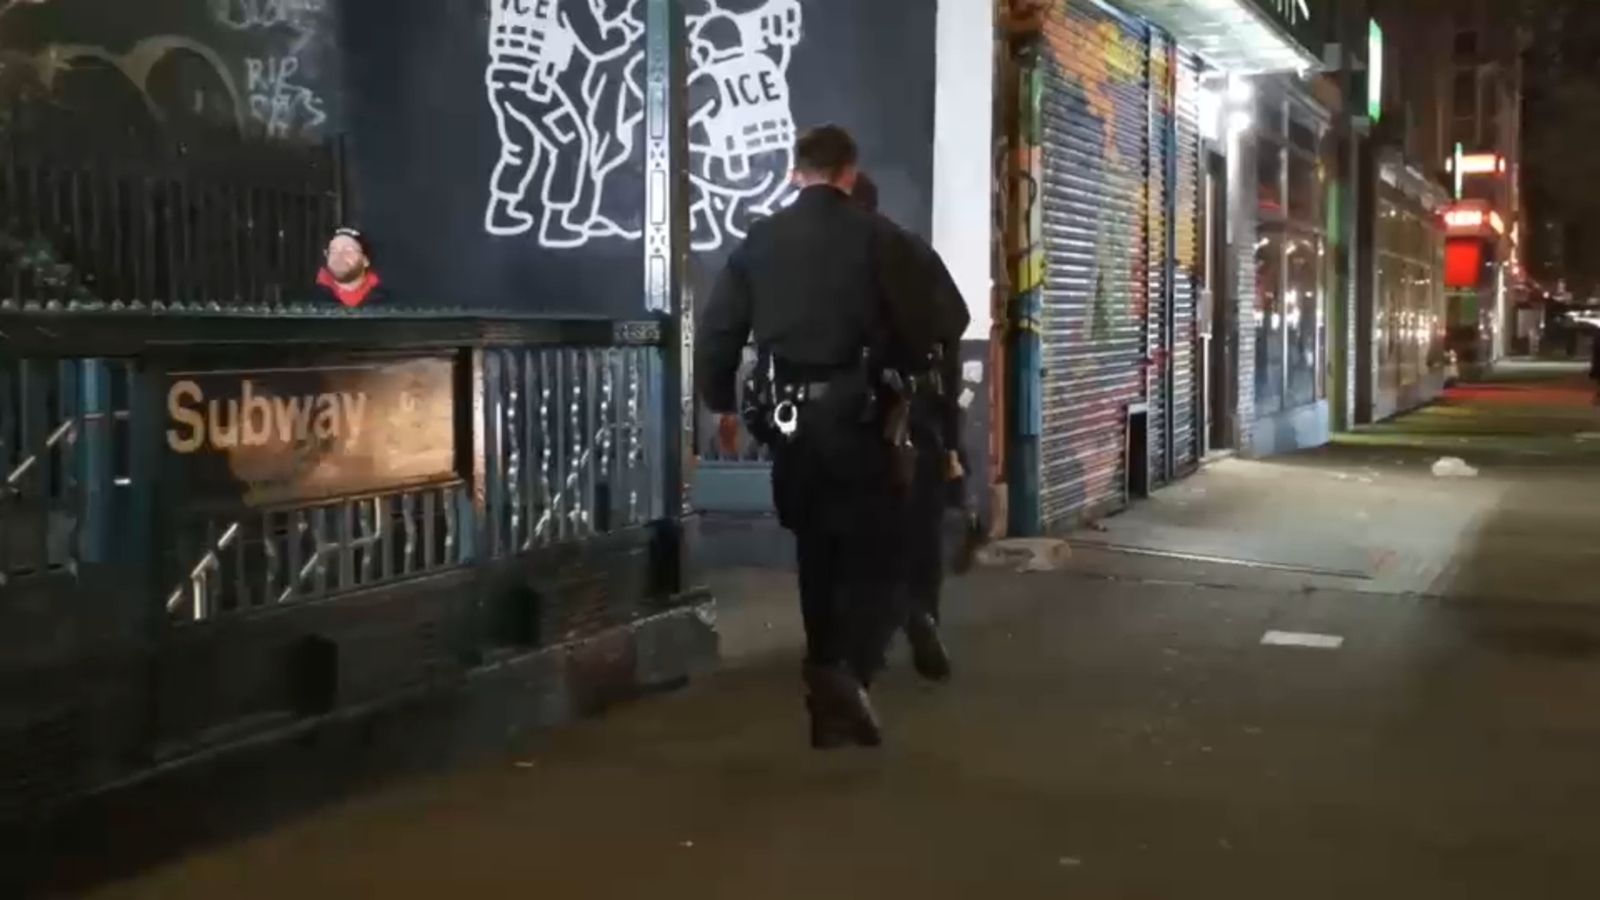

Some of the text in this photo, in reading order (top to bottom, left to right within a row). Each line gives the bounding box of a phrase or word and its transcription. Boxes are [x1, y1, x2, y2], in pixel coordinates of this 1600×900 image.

[245, 55, 298, 95] RIP
[724, 71, 781, 107] ICE
[166, 379, 367, 453] Subway
